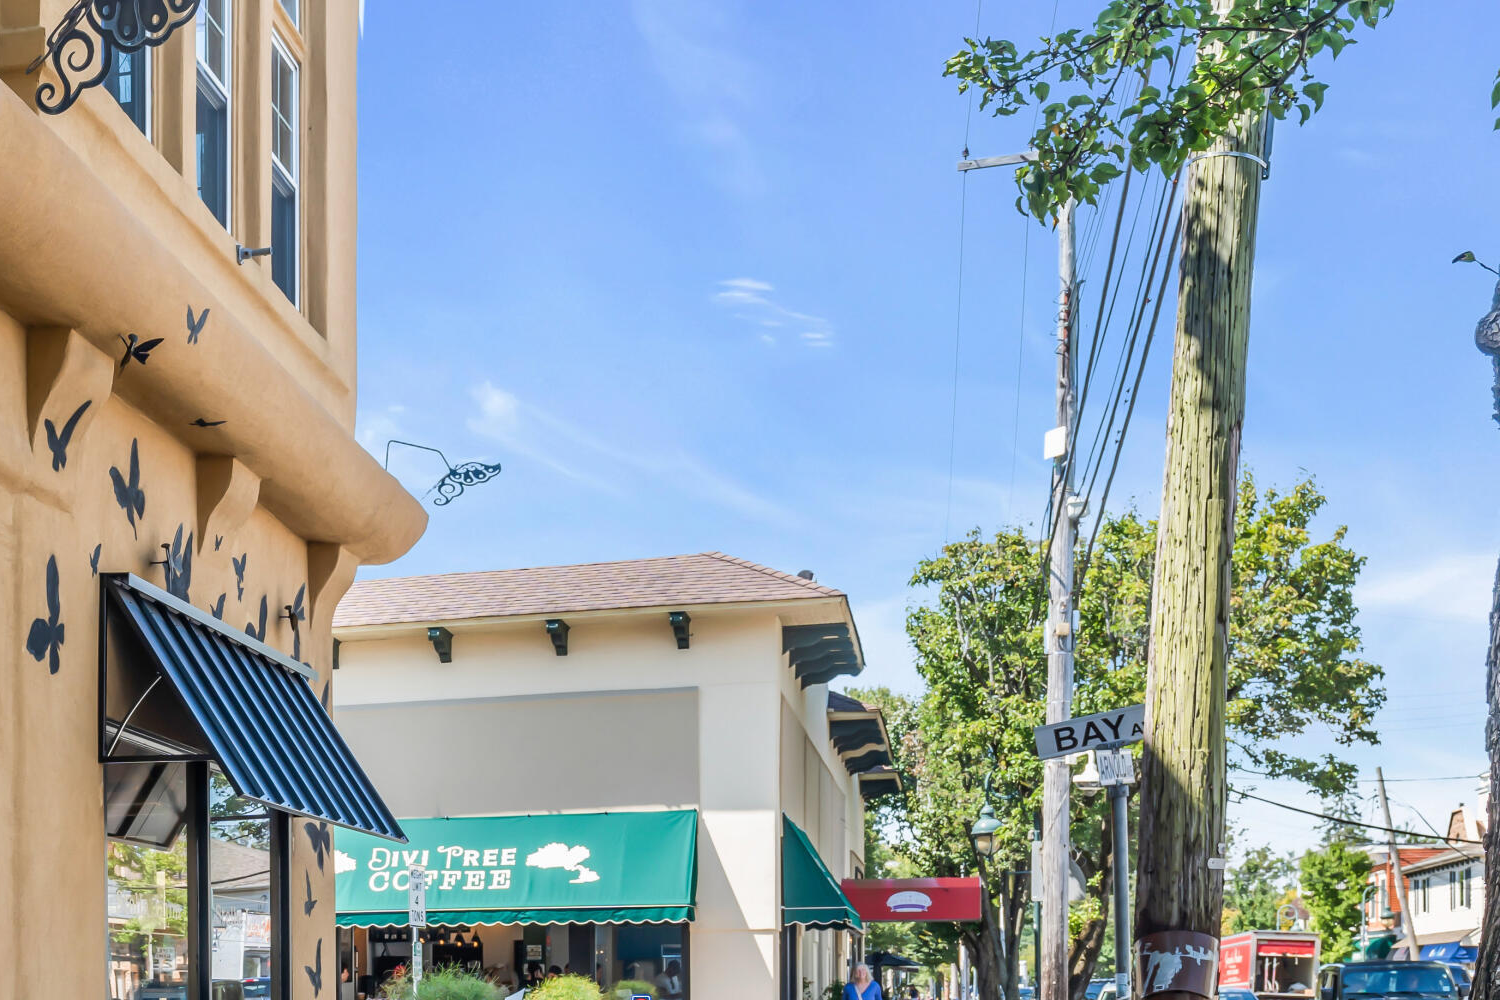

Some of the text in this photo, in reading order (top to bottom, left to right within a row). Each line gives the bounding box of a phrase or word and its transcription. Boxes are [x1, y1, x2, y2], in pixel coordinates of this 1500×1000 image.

[1053, 714, 1145, 752] BAY A
[368, 869, 511, 892] COFFEE
[411, 910, 424, 922] TONS
